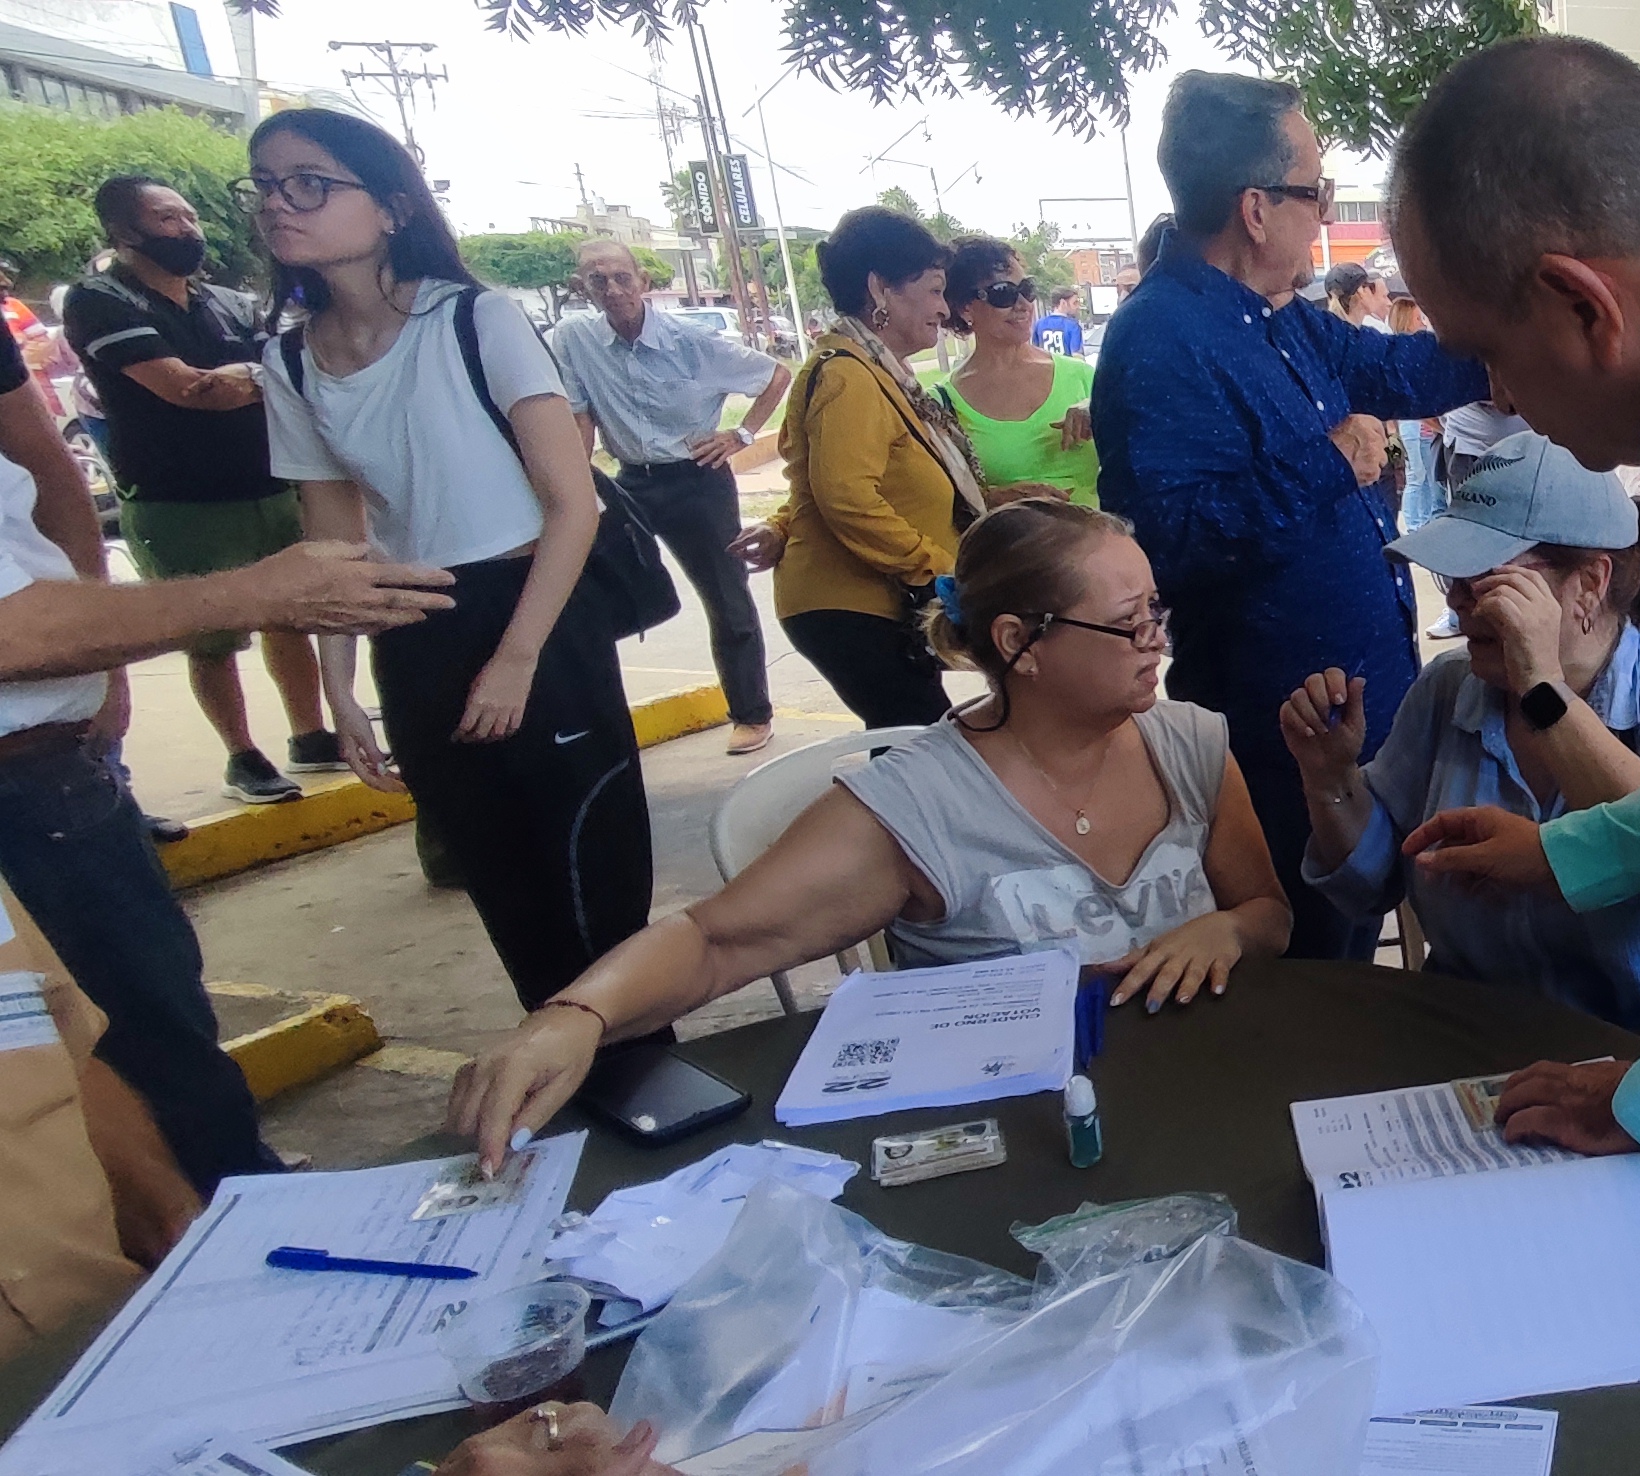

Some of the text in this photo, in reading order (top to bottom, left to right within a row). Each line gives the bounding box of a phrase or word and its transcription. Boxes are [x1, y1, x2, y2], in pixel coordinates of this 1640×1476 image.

[729, 158, 752, 225] CELULARES
[930, 1013, 1041, 1031] CUADERNO DE
[821, 1076, 891, 1094] 22
